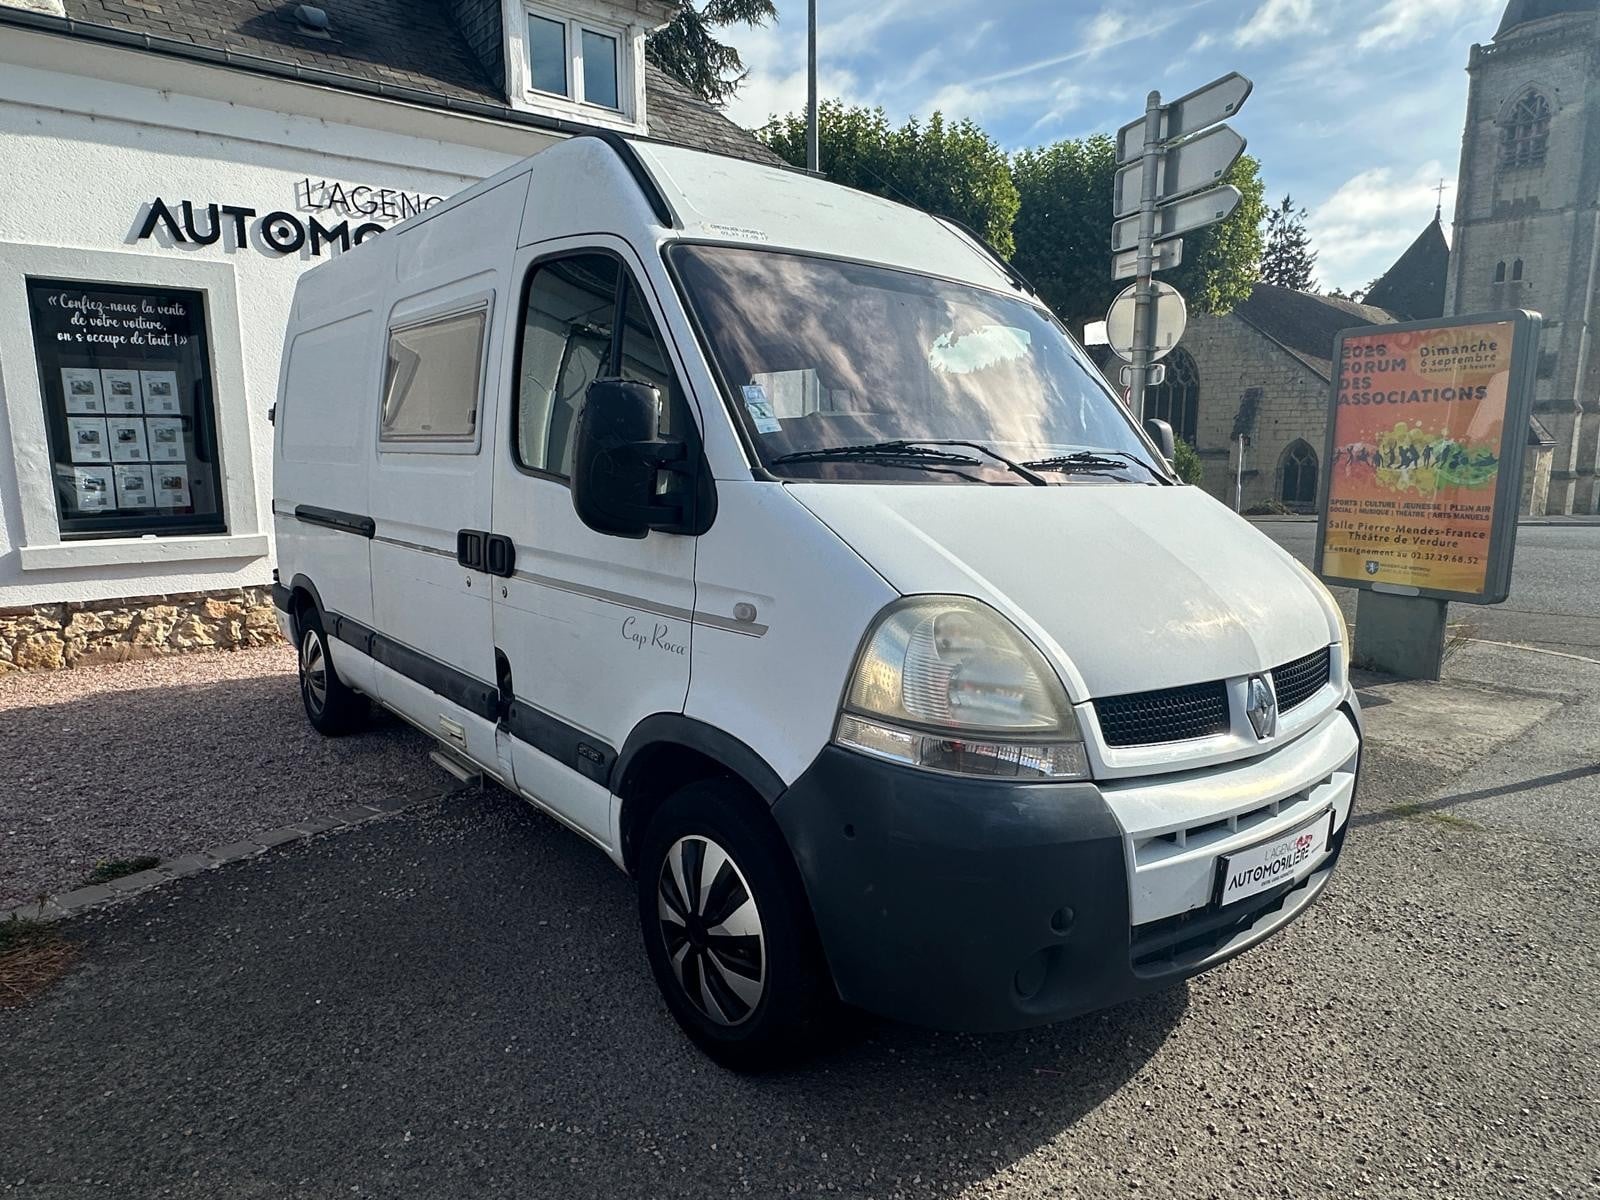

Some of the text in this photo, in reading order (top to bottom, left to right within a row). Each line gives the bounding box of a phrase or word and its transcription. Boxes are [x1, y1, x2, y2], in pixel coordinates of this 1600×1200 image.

[60, 293, 137, 315] Confiez-nous
[141, 300, 155, 313] la
[157, 303, 186, 316] vente
[71, 311, 87, 325] de
[89, 314, 120, 327] votre
[57, 332, 72, 341] on
[75, 328, 127, 348] s'occupe
[130, 331, 145, 345] de
[144, 332, 172, 346] tout
[1420, 339, 1498, 357] Dimanche
[1340, 358, 1407, 374] FORUM
[1420, 353, 1497, 368] 6 septembre
[1339, 376, 1372, 390] DES
[1338, 385, 1488, 406] ASSOCIATIONS
[1364, 500, 1396, 509] CULTURE
[1450, 504, 1475, 512] PLEIN
[1328, 520, 1354, 530] Salle
[1454, 513, 1489, 521] MANUELS
[1394, 534, 1408, 544] de
[1412, 536, 1458, 548] Verdure
[621, 616, 686, 656] Cap Roca
